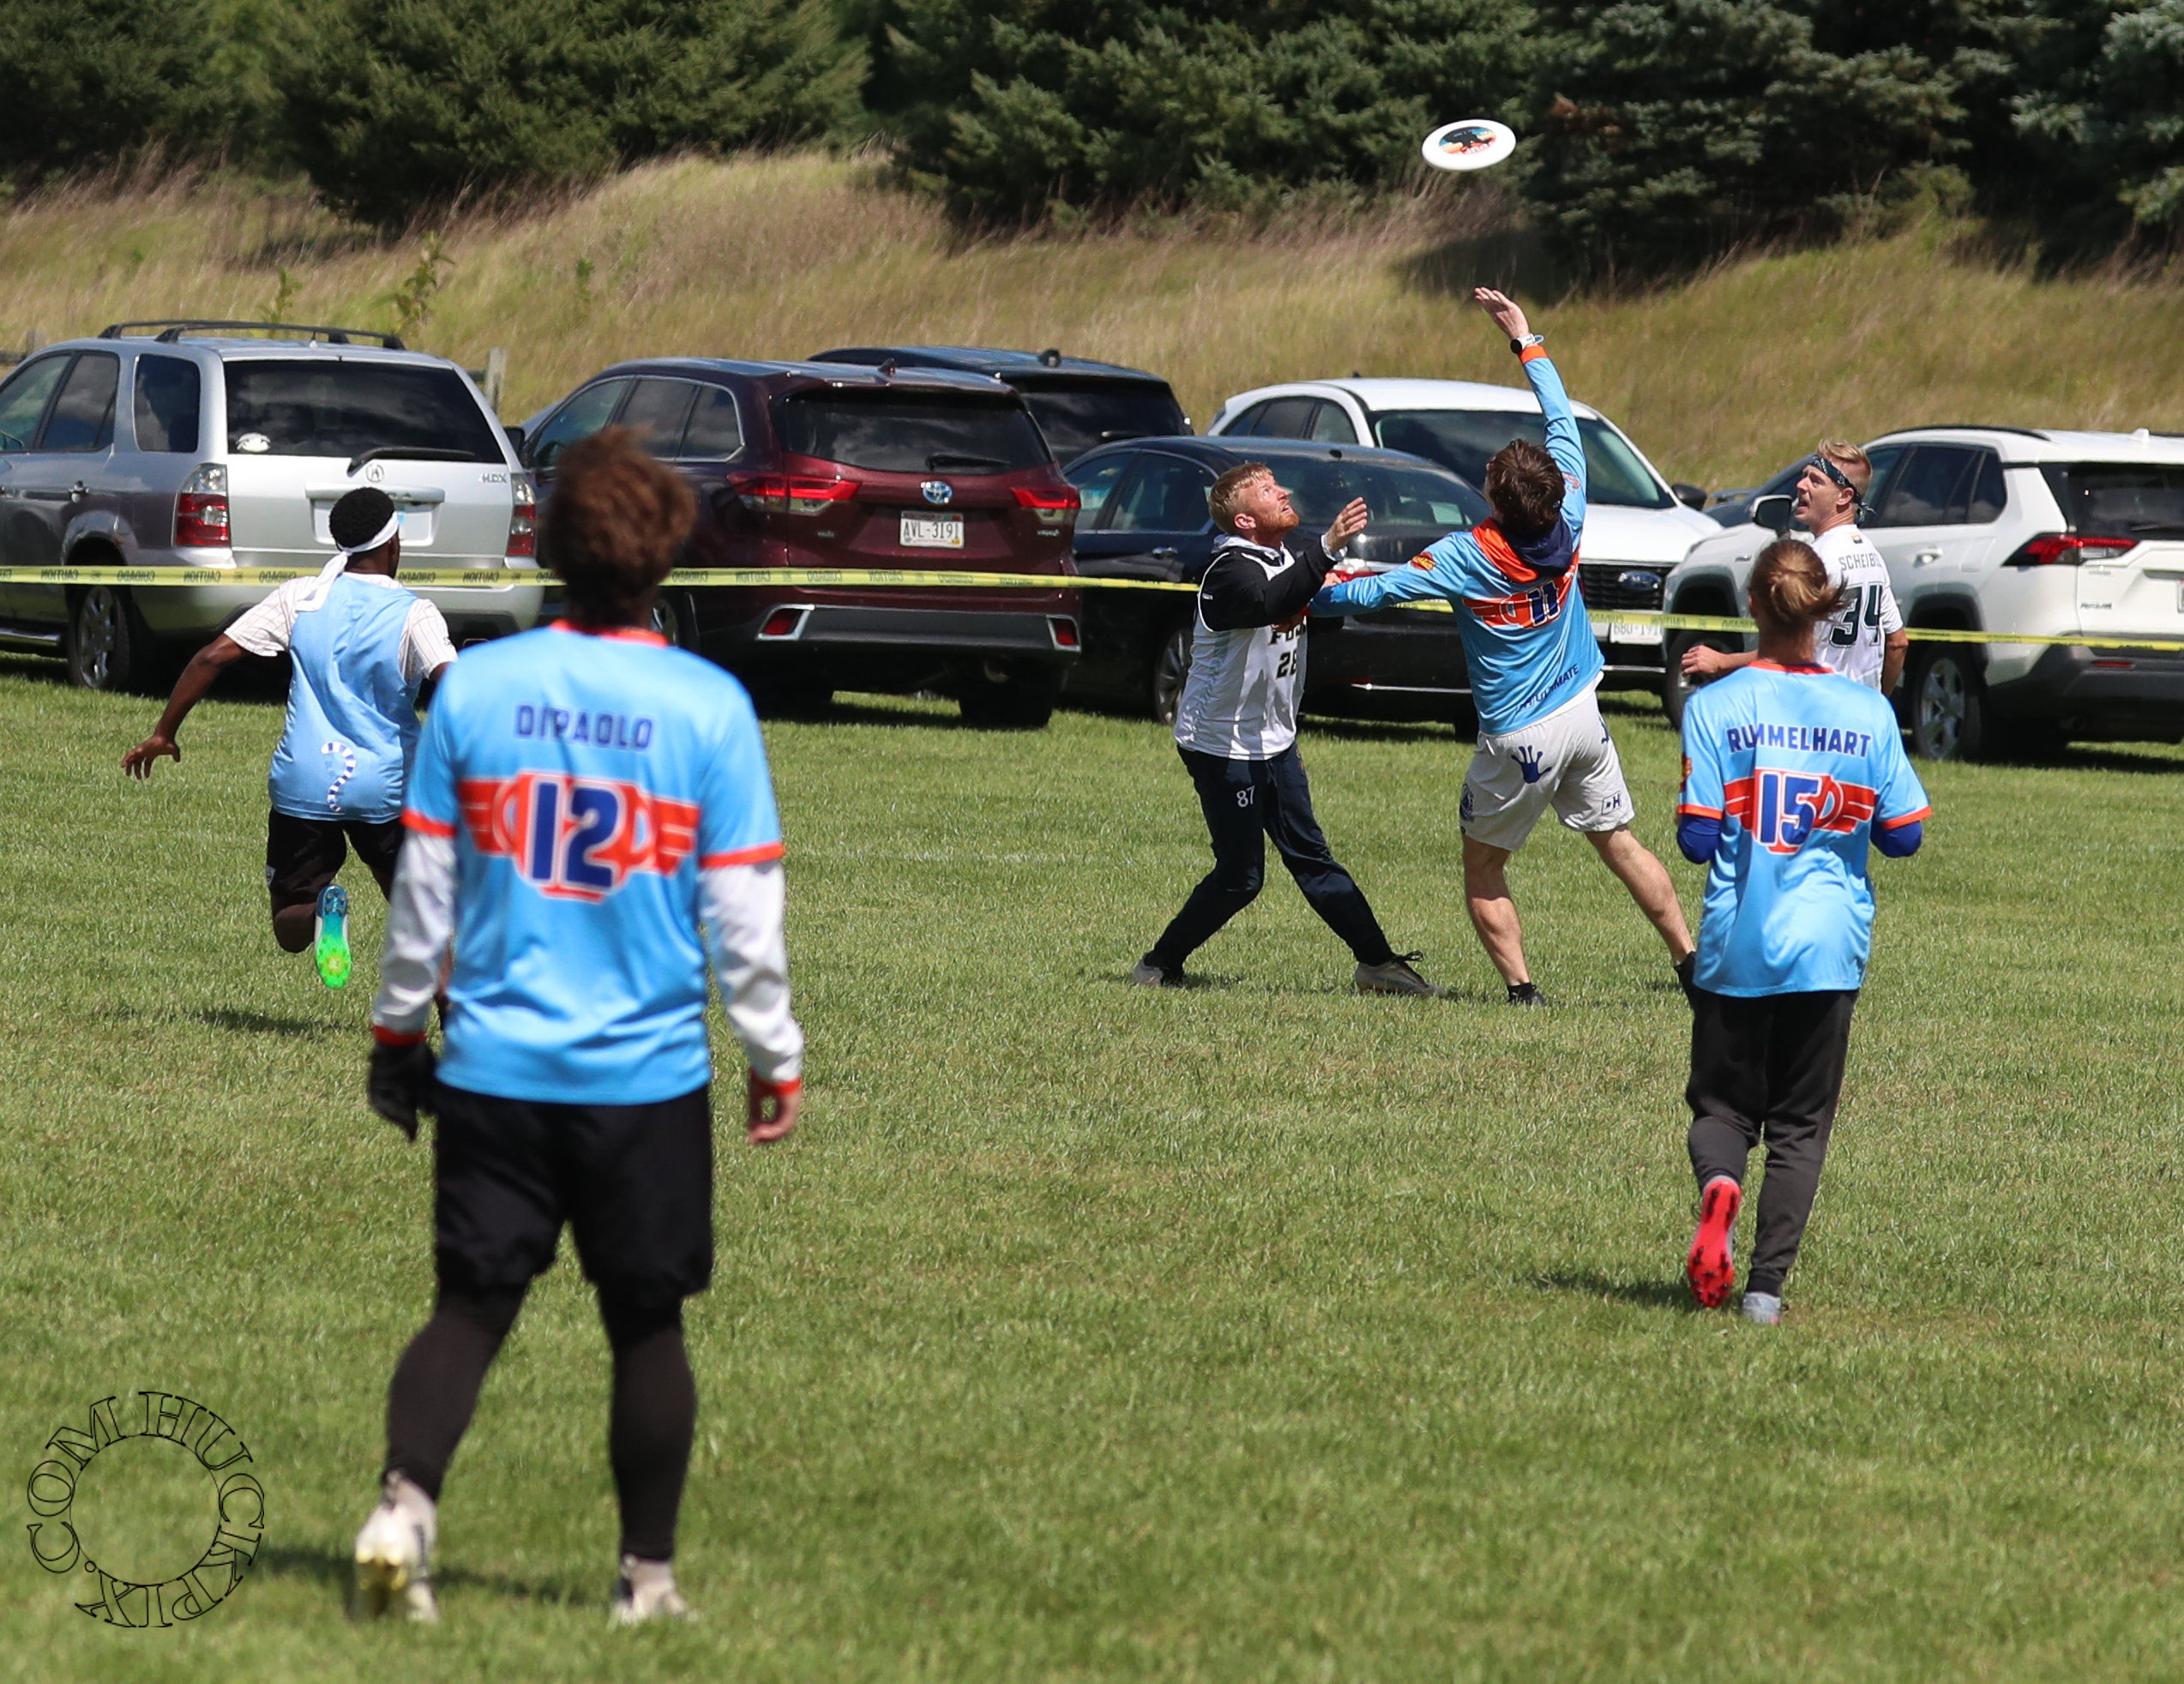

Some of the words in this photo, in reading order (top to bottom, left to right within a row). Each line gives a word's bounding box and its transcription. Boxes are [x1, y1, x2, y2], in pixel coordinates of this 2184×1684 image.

[903, 520, 959, 539] AVL-3191
[1525, 580, 1560, 627] 11
[1830, 583, 1884, 646] 34
[518, 705, 653, 749] DIPAOLO
[1726, 722, 1872, 758] RUMMELHART
[1236, 785, 1255, 807] 87
[1759, 772, 1821, 846] 15
[528, 779, 622, 889] 12
